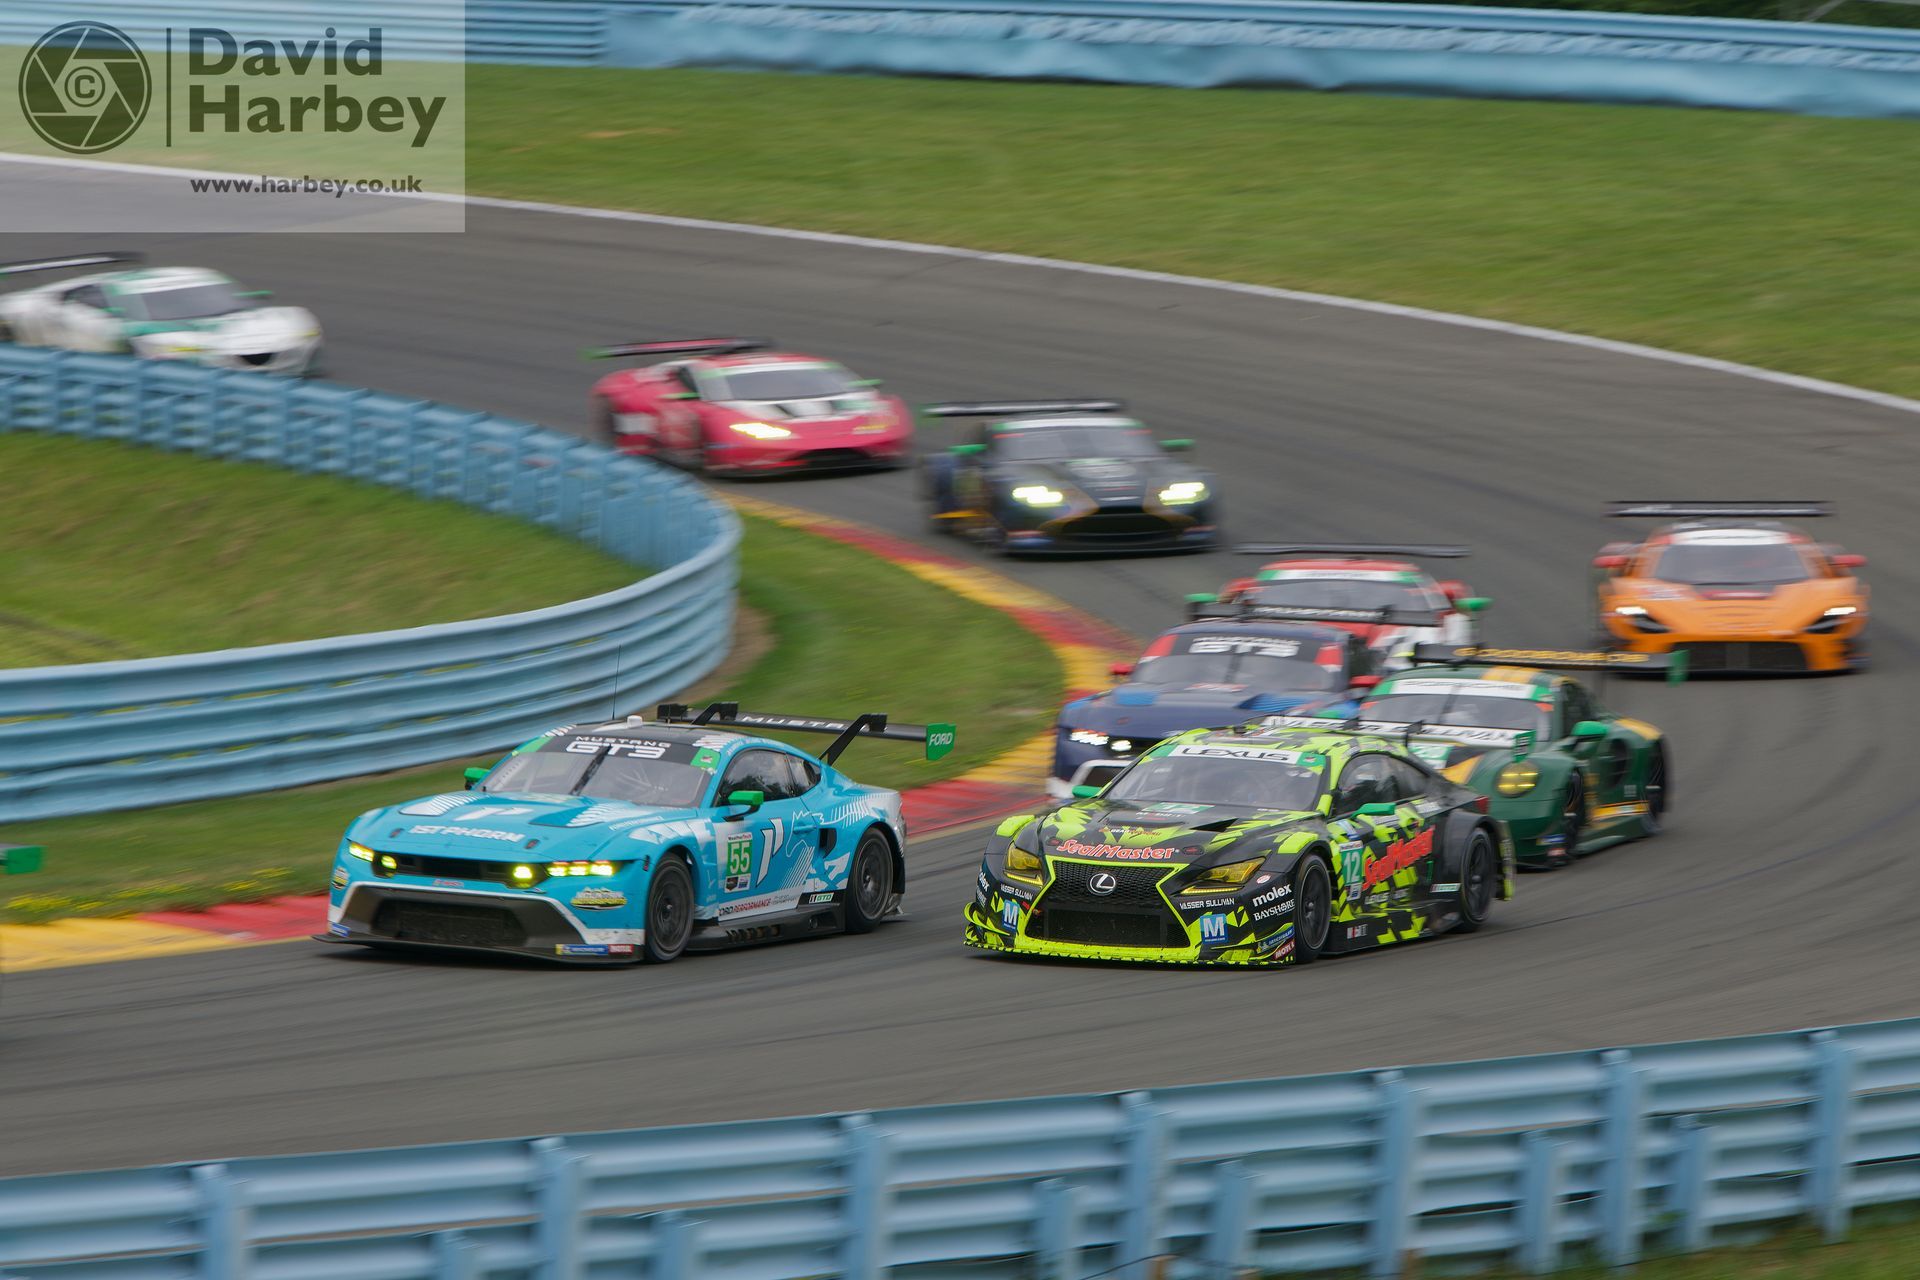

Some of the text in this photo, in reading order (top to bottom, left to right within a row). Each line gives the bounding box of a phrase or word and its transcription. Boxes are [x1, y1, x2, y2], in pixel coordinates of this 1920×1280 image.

[1189, 641, 1300, 658] GT3
[575, 735, 672, 748] MUSTANG
[928, 732, 953, 747] FORD
[565, 741, 666, 759] GT3
[1182, 747, 1288, 761] LEXUS
[730, 841, 750, 874] 55
[1056, 839, 1175, 859] SealMaster
[1344, 851, 1360, 883] 12
[1180, 898, 1235, 910] VASSER SULLIVAN
[1252, 884, 1292, 907] molex
[1253, 899, 1295, 921] BAYSHORE
[1203, 916, 1225, 938] M
